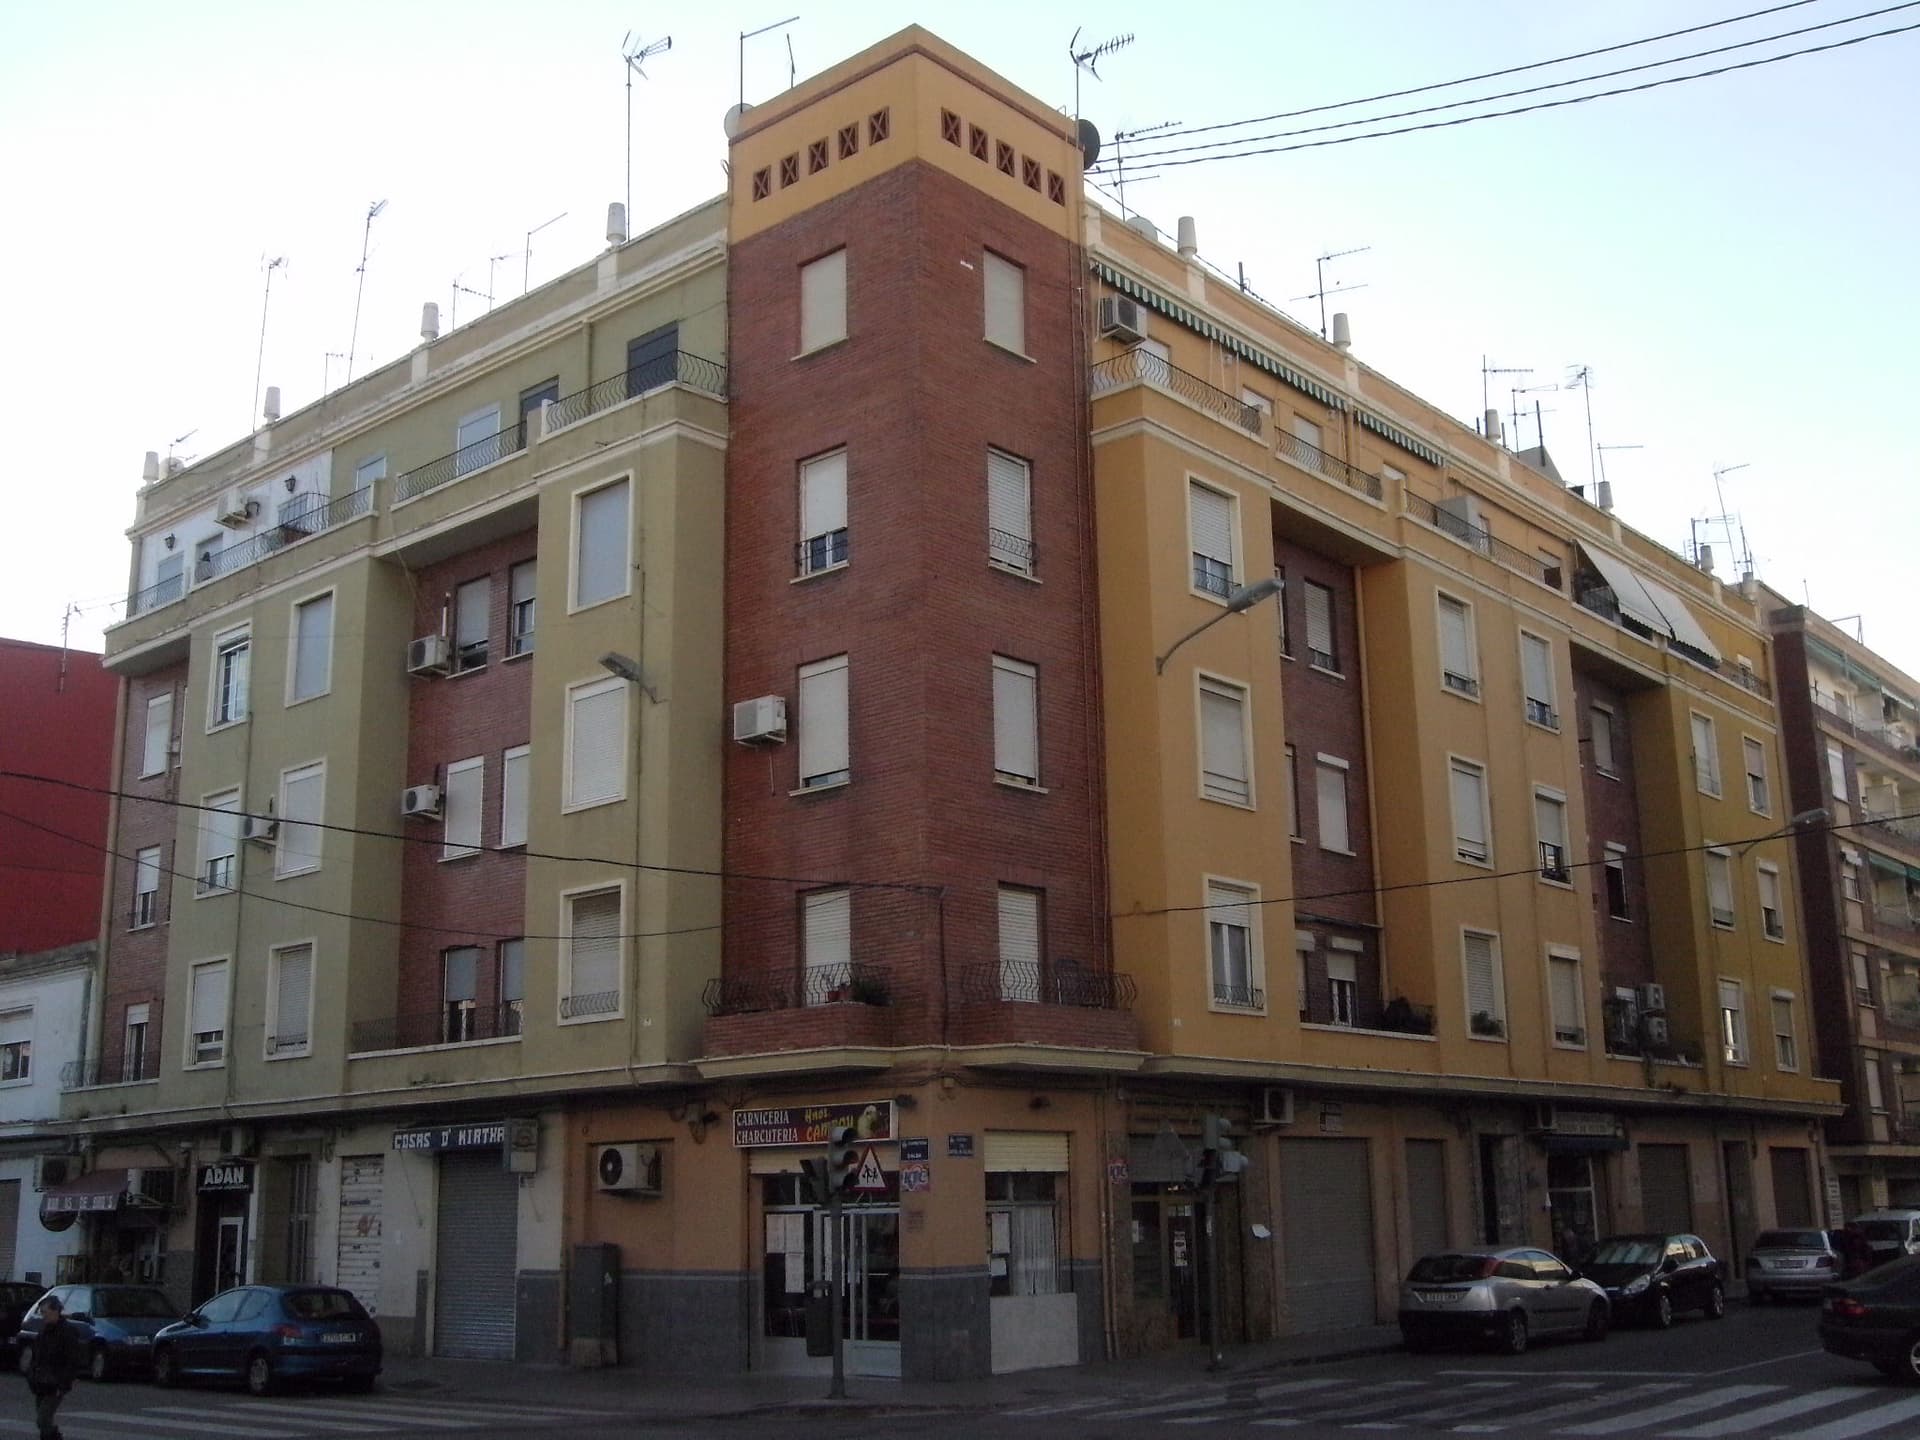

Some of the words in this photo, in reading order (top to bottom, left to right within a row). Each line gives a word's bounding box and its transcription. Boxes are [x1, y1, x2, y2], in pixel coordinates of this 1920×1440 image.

[736, 1110, 790, 1126] CARNICERIA
[394, 1131, 432, 1149] COSAS
[736, 1127, 798, 1144] CHARCUTERIA
[204, 1166, 244, 1185] ADAN
